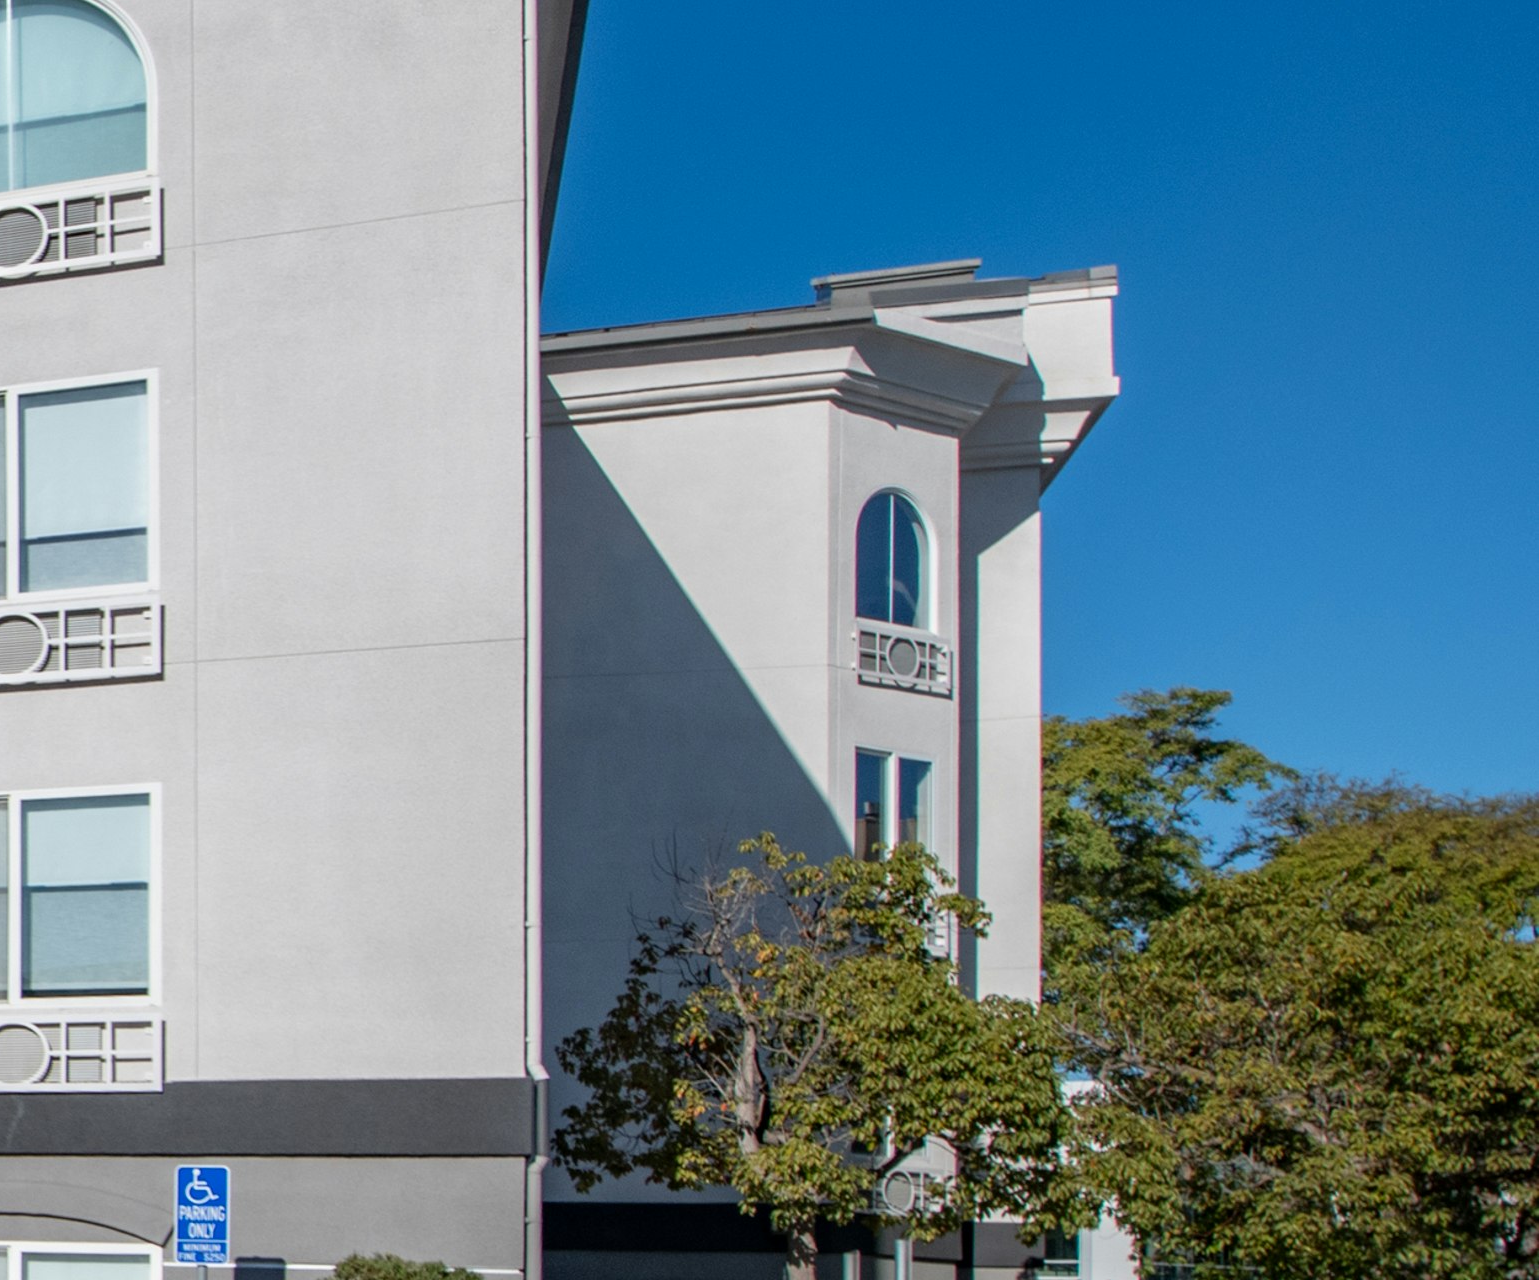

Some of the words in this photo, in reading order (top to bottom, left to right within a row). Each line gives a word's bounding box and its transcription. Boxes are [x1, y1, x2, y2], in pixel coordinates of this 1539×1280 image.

[179, 1205, 226, 1222] PARKING
[188, 1222, 216, 1239] ONLY
[183, 1243, 221, 1251] MINIMUM
[179, 1252, 196, 1261] FINE
